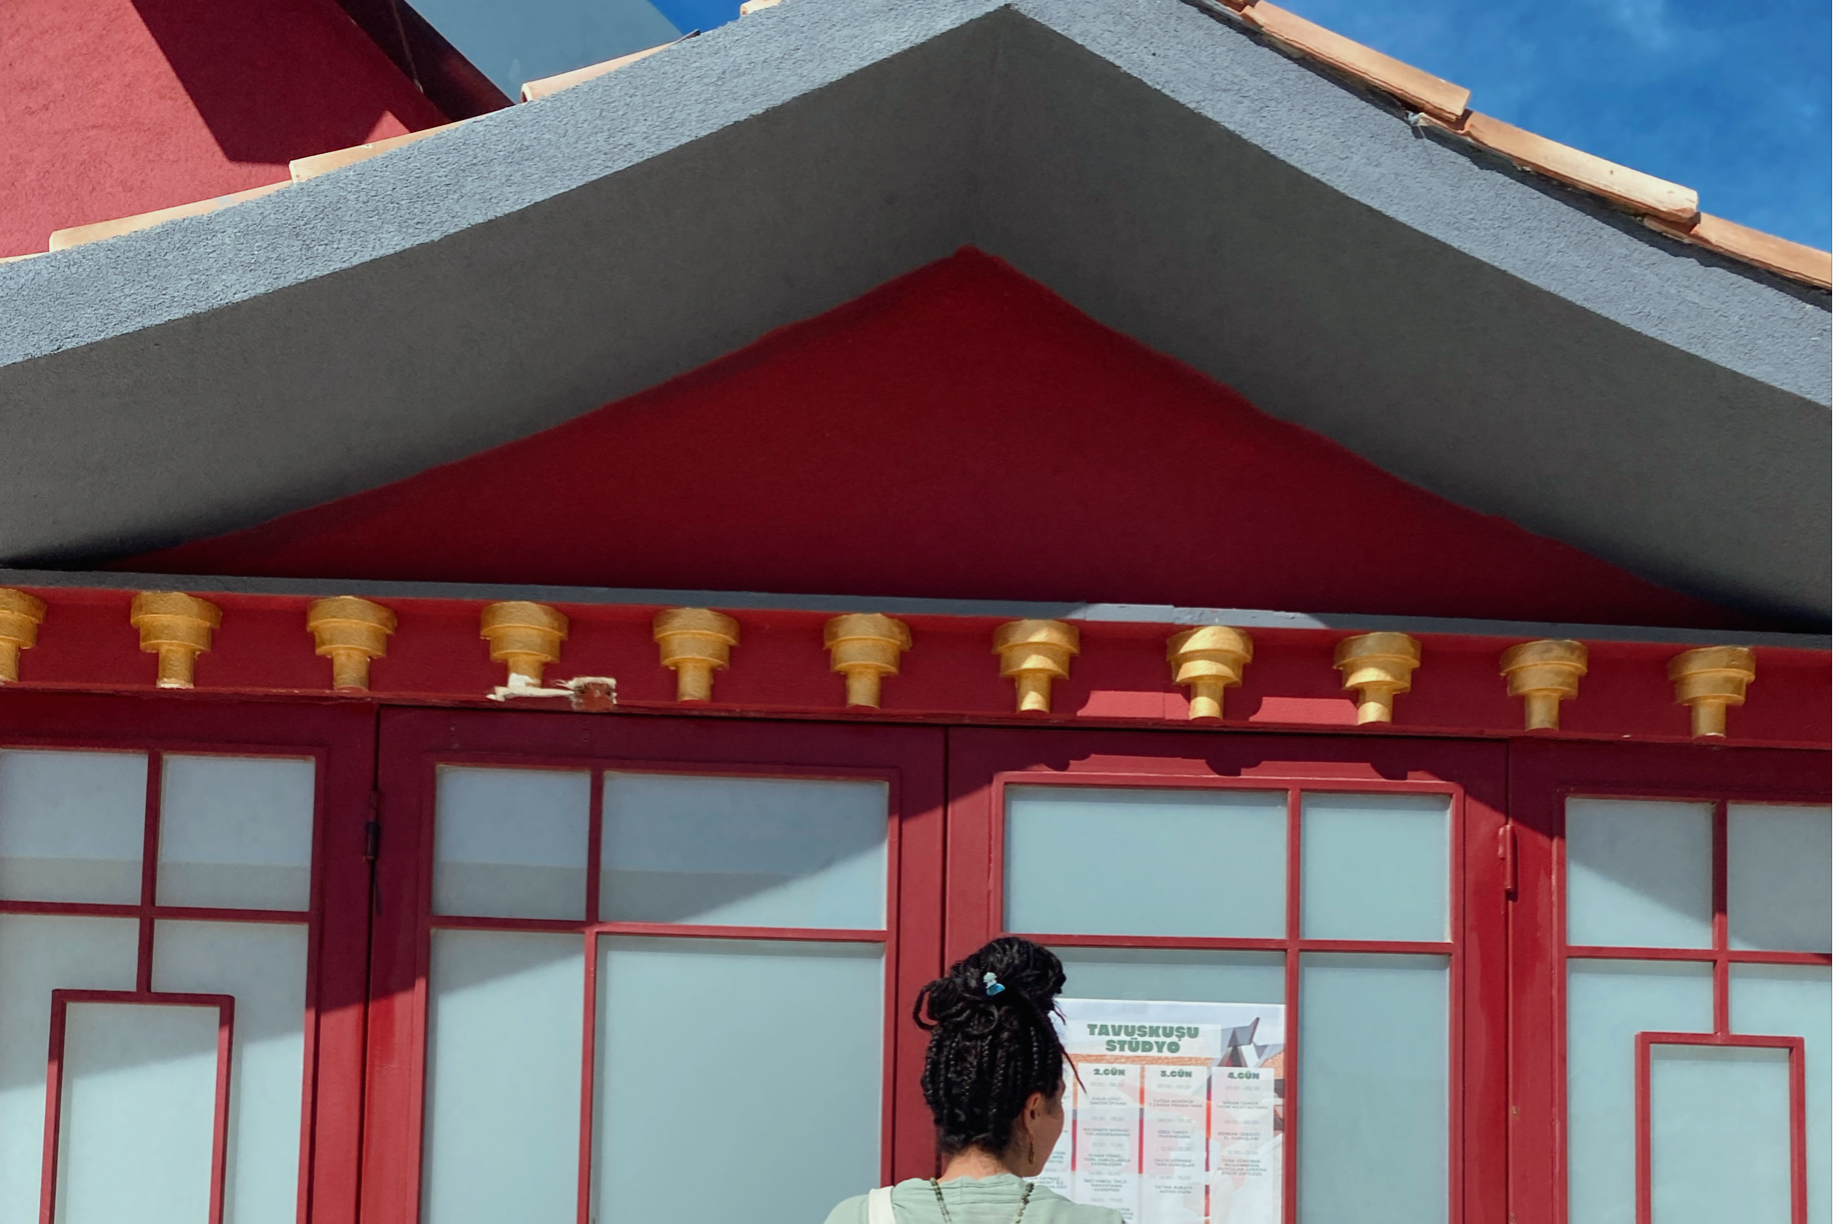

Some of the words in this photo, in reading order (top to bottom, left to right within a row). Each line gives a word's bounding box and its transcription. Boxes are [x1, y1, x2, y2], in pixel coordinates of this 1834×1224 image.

[1087, 1024, 1200, 1042] TAVUSKUŞU
[1105, 1037, 1181, 1054] STÜDYO
[1093, 1067, 1126, 1077] 2.GÜN
[1160, 1069, 1193, 1078] 3.GÜN
[1227, 1071, 1260, 1080] 4.GÜN
